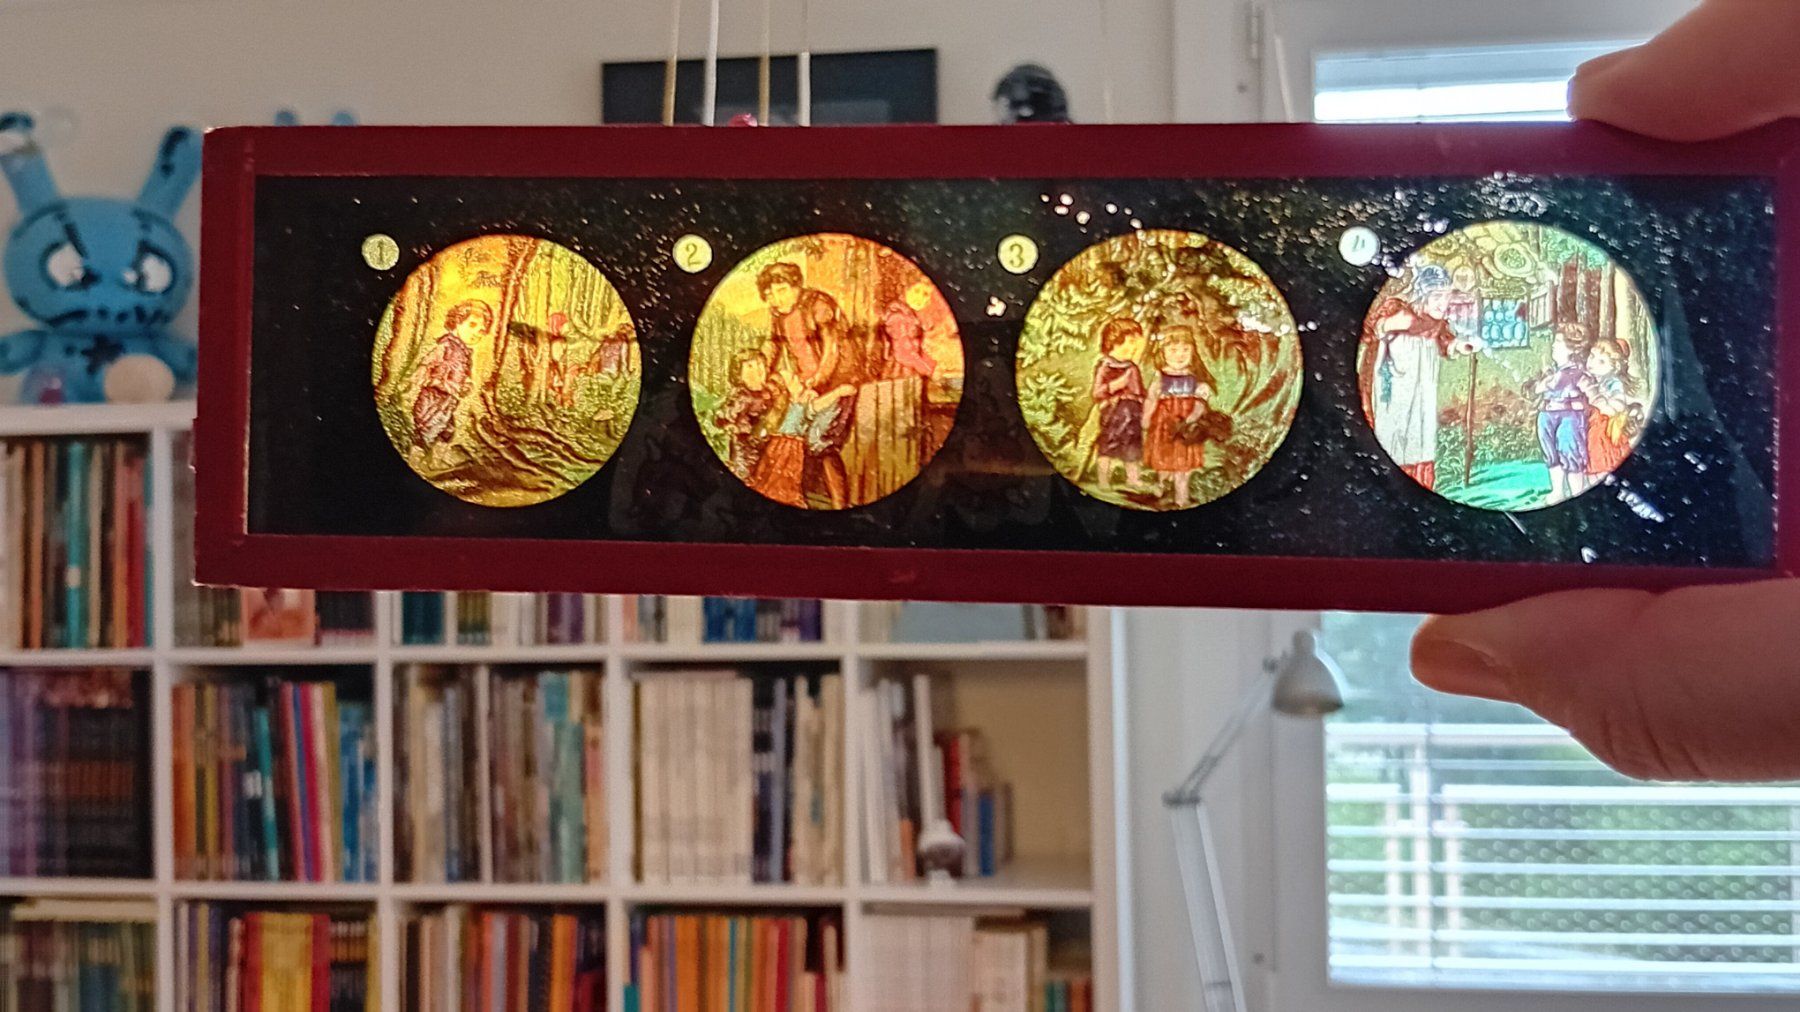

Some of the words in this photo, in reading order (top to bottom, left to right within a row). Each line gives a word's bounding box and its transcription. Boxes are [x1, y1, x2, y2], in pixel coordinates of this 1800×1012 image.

[377, 240, 386, 265] 1
[685, 242, 700, 267] 2
[1009, 242, 1025, 268] 3
